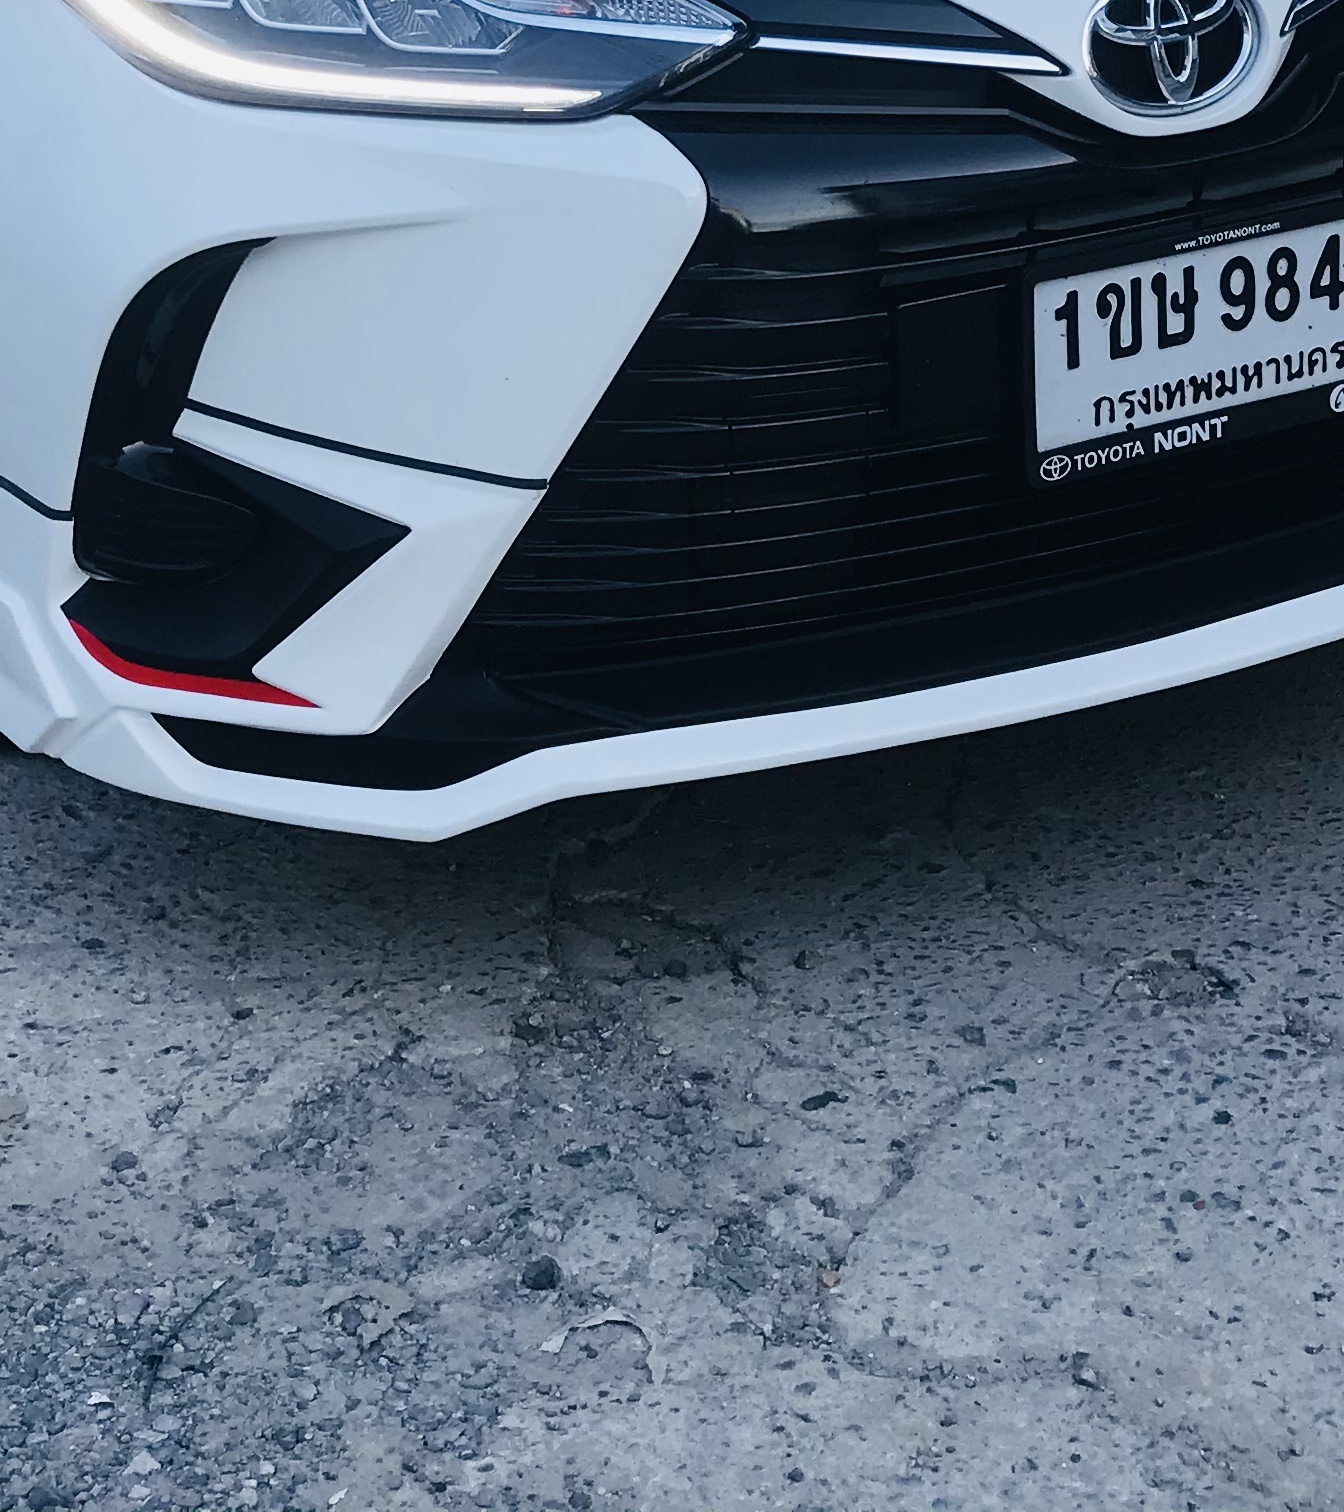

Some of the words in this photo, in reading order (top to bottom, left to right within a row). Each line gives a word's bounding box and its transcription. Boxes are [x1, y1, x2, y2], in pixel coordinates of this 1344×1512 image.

[1174, 221, 1280, 251] www.TOYOTANONT.com
[1055, 265, 1198, 370] 1ขษ
[1074, 440, 1145, 471] TOYOTA
[1154, 416, 1229, 453] NONT
